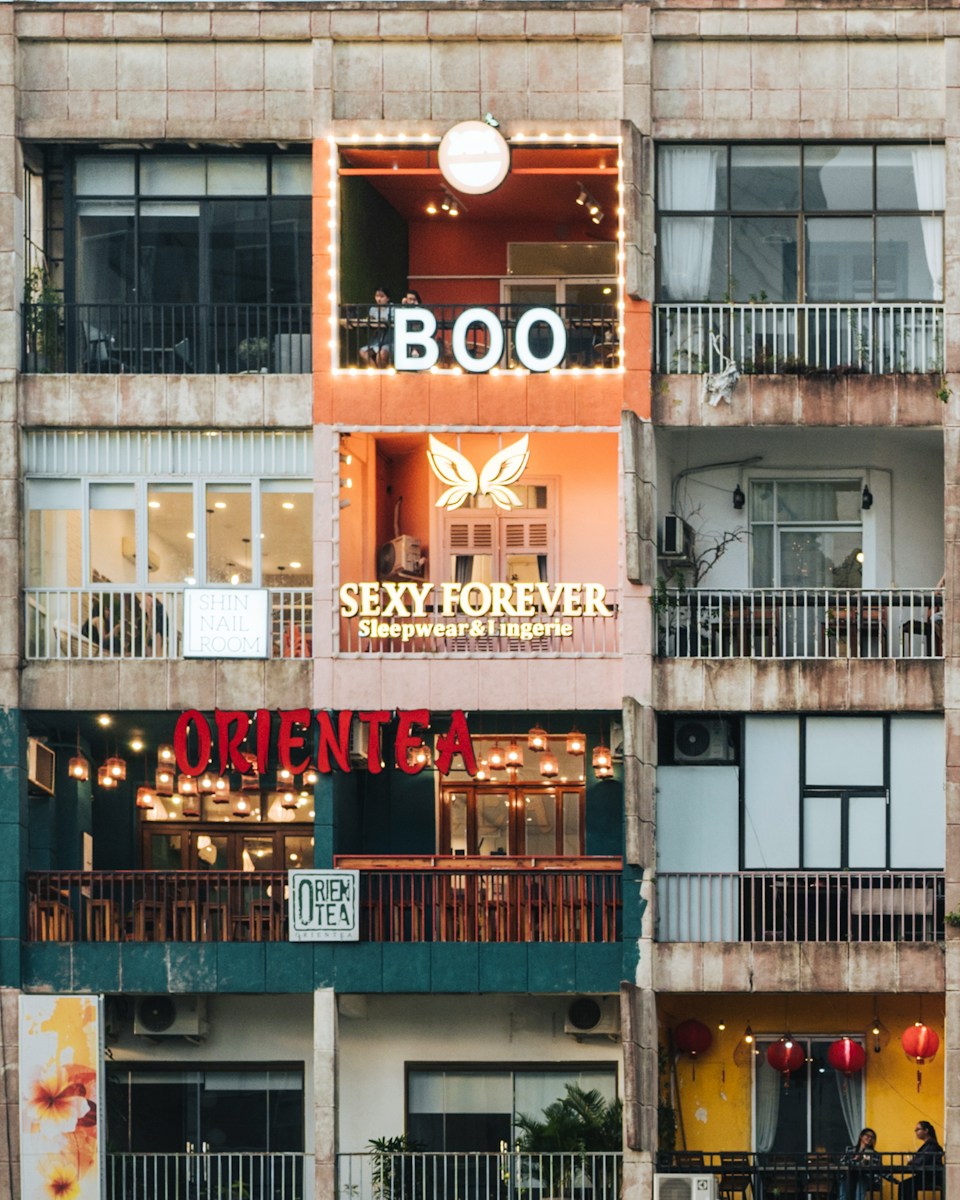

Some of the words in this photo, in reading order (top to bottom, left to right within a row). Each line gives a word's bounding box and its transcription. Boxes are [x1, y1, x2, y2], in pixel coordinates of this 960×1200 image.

[394, 307, 566, 373] BOO
[200, 594, 248, 610] SHIN
[339, 582, 434, 618] SEXY
[441, 582, 614, 618] FOREVER
[200, 615, 249, 632] NAIL
[200, 636, 260, 652] ROOM
[173, 707, 478, 776] ORIENTEA
